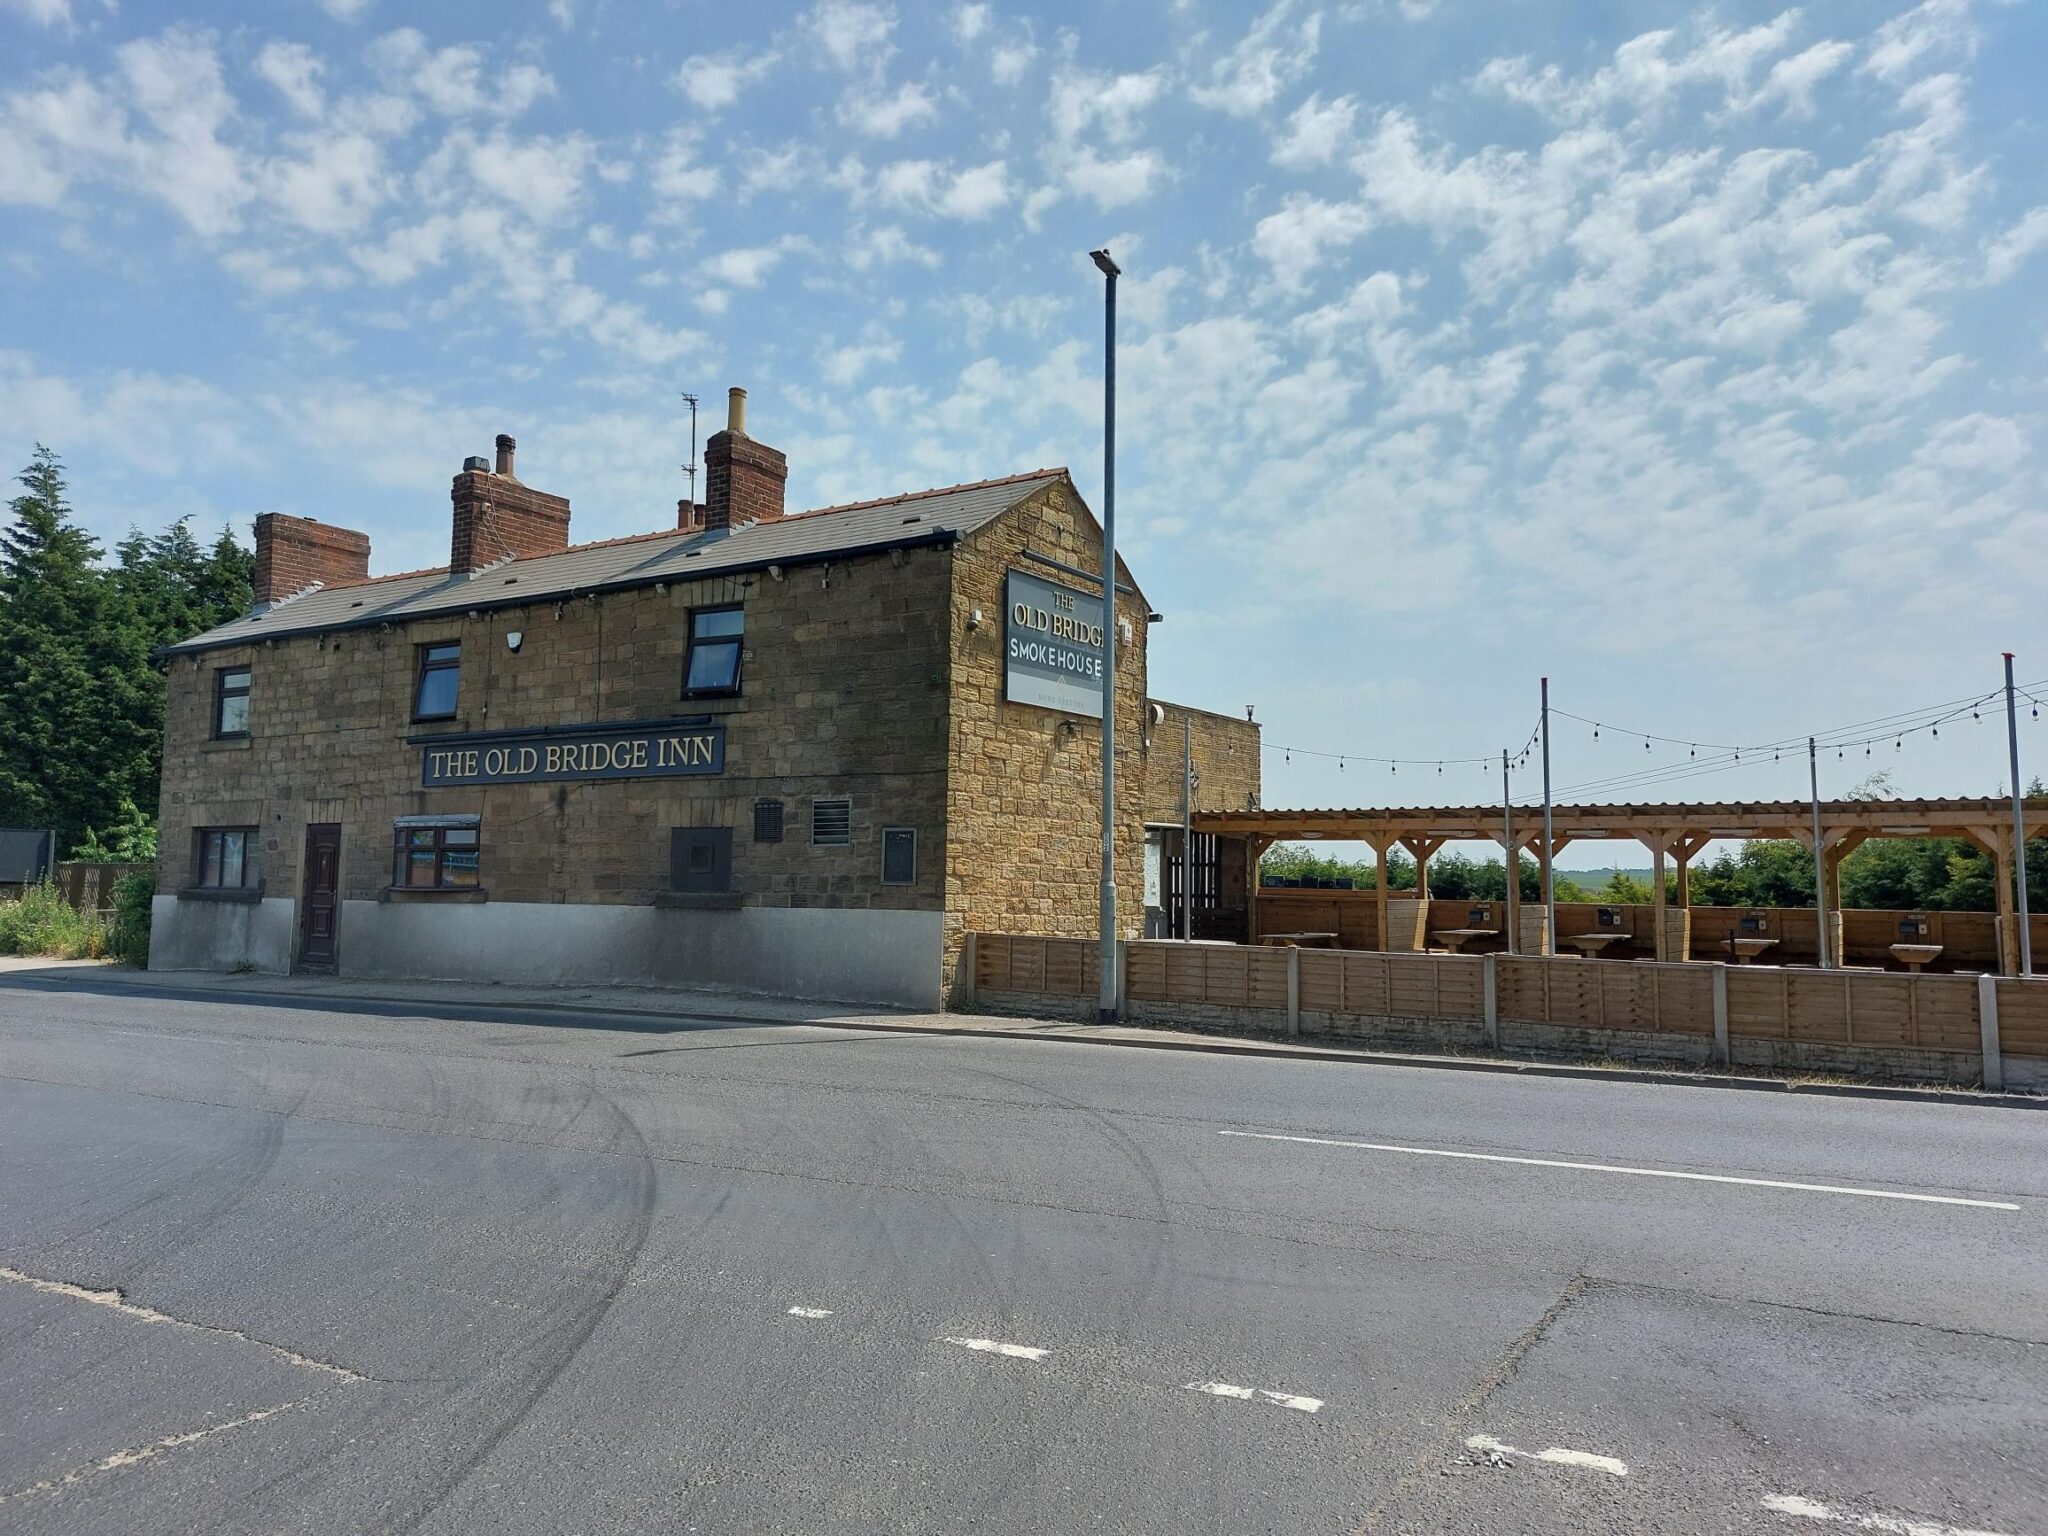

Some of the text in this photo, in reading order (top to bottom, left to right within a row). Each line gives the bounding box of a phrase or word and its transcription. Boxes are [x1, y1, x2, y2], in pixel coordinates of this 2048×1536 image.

[1014, 602, 1049, 632] OLD
[1052, 590, 1075, 611] THE
[1010, 638, 1102, 677] SMOKEHOUSE
[430, 735, 715, 778] THE OLD BRIDGE INN
